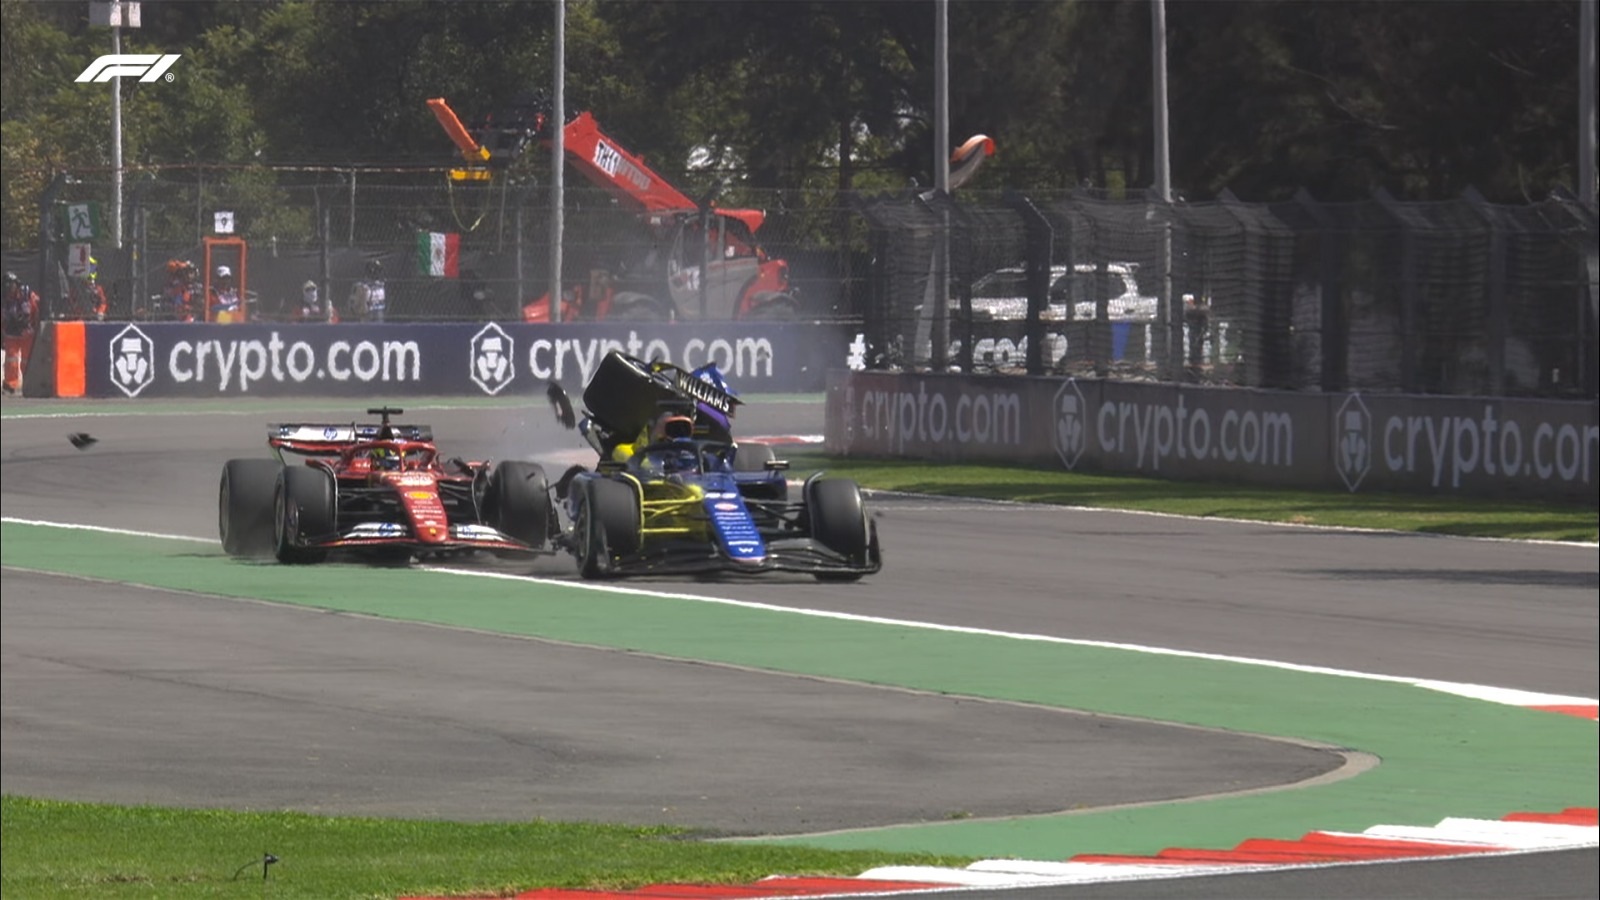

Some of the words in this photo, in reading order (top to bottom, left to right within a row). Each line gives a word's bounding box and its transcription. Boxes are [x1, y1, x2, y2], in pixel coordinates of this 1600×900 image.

[169, 331, 420, 391] crypto.com
[529, 330, 773, 389] crytocom
[678, 371, 731, 412] WILLIAMS
[862, 380, 1020, 454] crypto.com
[1098, 394, 1292, 470] crypto.com
